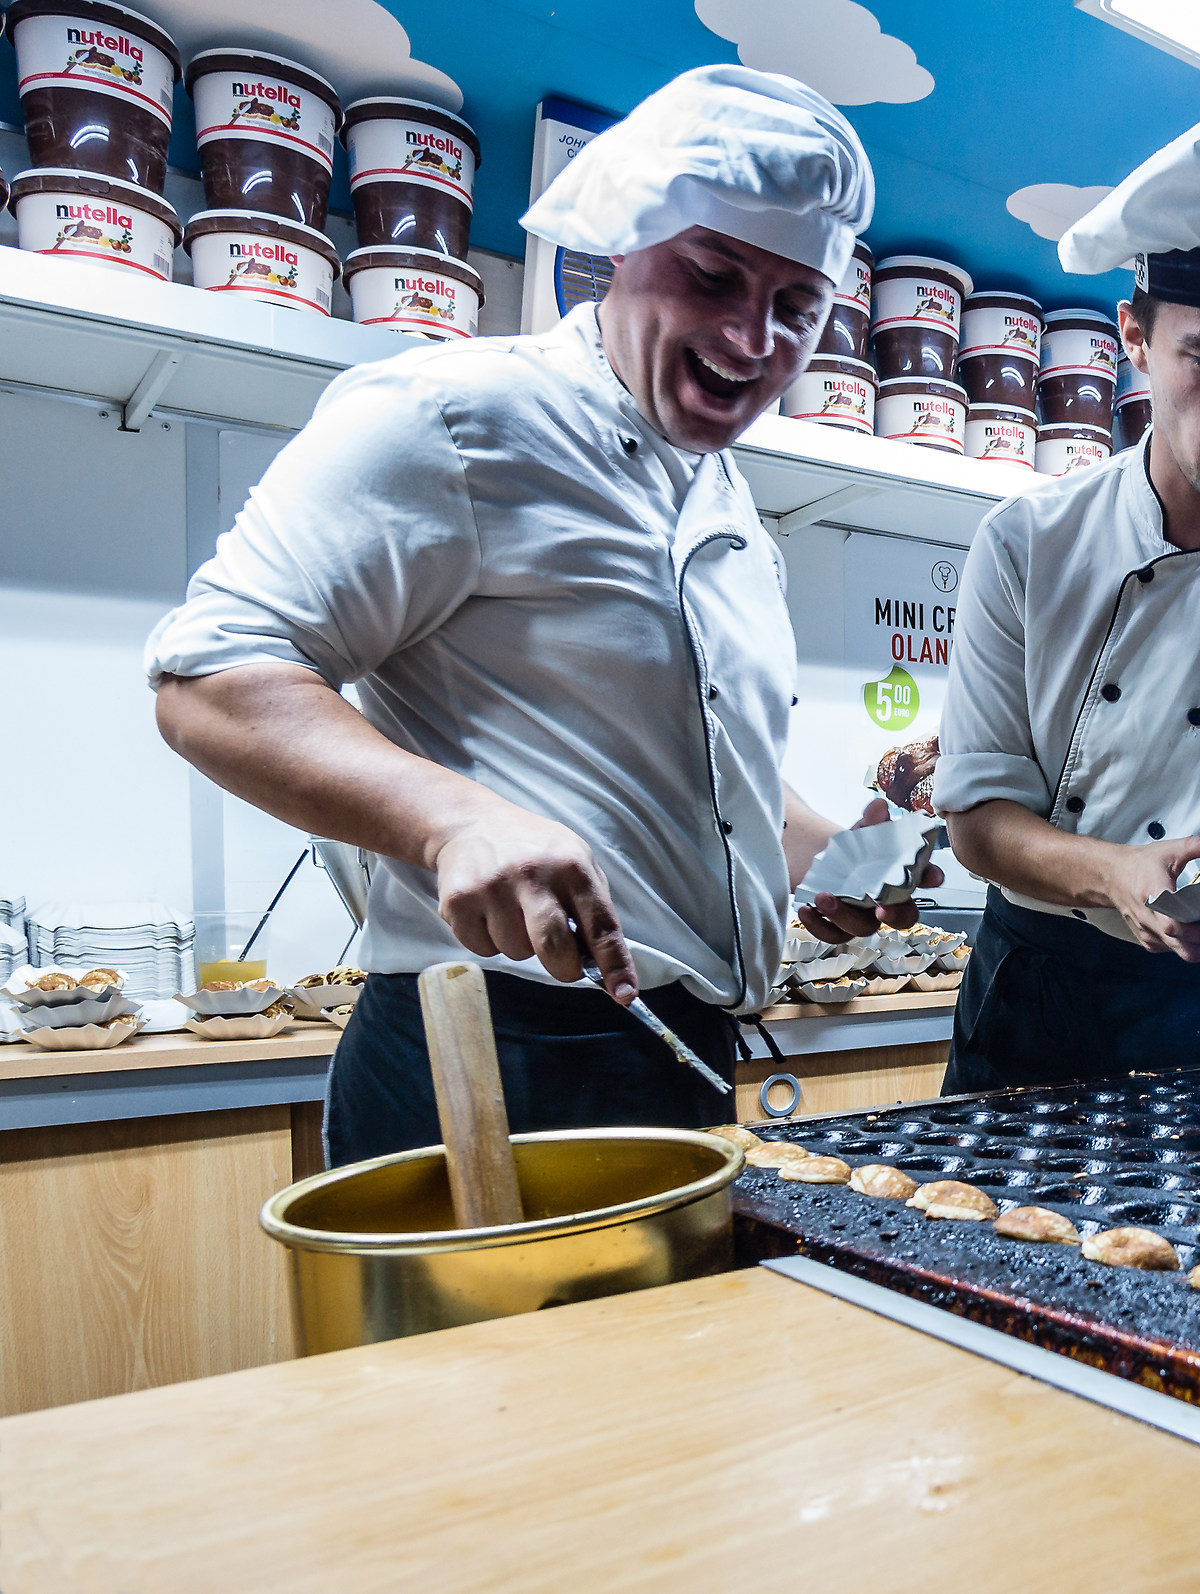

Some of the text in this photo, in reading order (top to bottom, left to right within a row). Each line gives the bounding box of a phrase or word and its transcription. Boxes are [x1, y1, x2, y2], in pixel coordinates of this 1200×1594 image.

[67, 28, 143, 62] nutella
[232, 82, 301, 109] nutella
[406, 131, 462, 160] nutella
[56, 204, 132, 230] nutella
[230, 243, 298, 266] nutella
[857, 268, 871, 284] nut
[395, 278, 456, 300] nutella
[917, 286, 955, 305] nutella
[1005, 316, 1038, 333] nutella
[1090, 338, 1117, 355] nutella
[824, 380, 866, 397] nutella
[914, 401, 955, 417] nutella
[985, 426, 1025, 439] nutella
[1067, 444, 1102, 458] nutella
[875, 598, 924, 630] MINI
[891, 633, 954, 666] OLAN
[894, 707, 910, 718] EURO
